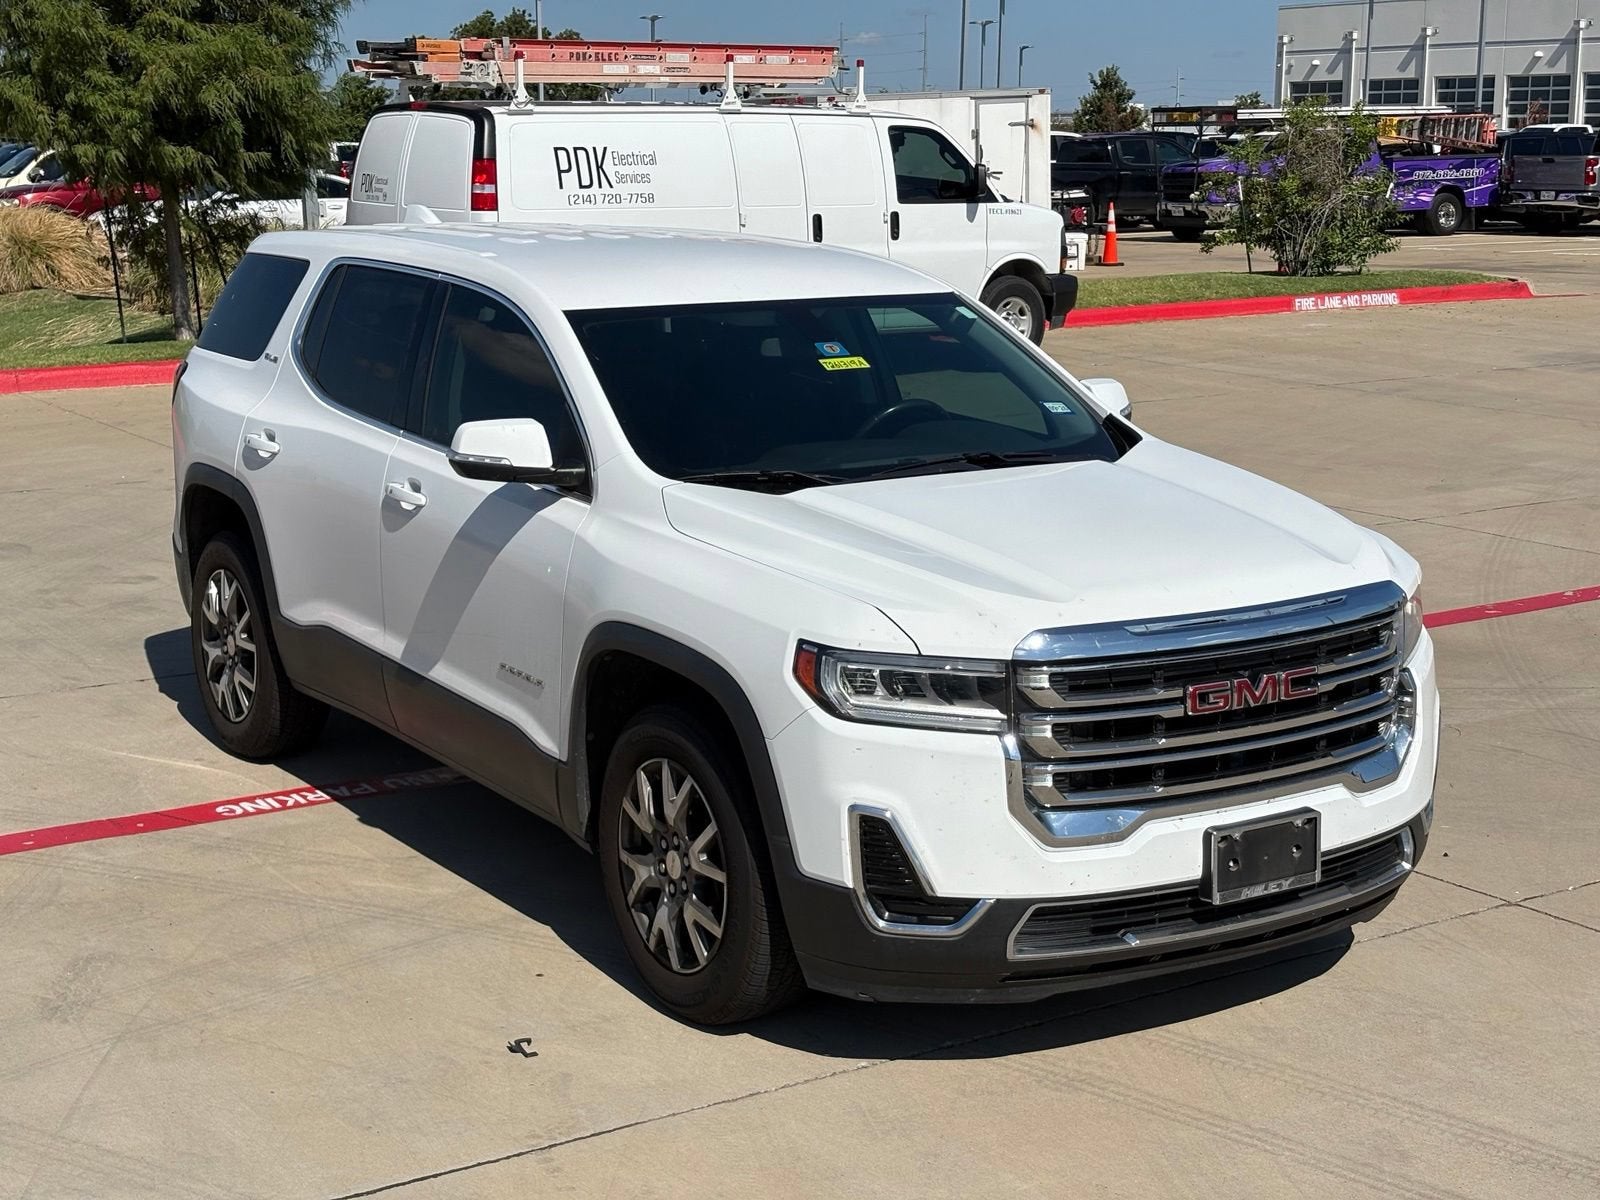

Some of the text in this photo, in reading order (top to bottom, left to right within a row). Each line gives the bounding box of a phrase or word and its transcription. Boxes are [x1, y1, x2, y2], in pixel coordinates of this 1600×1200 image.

[594, 51, 620, 62] ELEC
[553, 146, 657, 190] PDK Electrical
[1413, 168, 1485, 180] 972-682-4860
[360, 173, 376, 193] PDK
[614, 171, 651, 184] Services
[568, 193, 655, 206] (214) 720-7758
[1295, 293, 1398, 311] FIRE LANE NO PARKING
[1187, 665, 1318, 716] GMC
[215, 783, 378, 817] PARKING
[1241, 879, 1294, 898] HILEY
